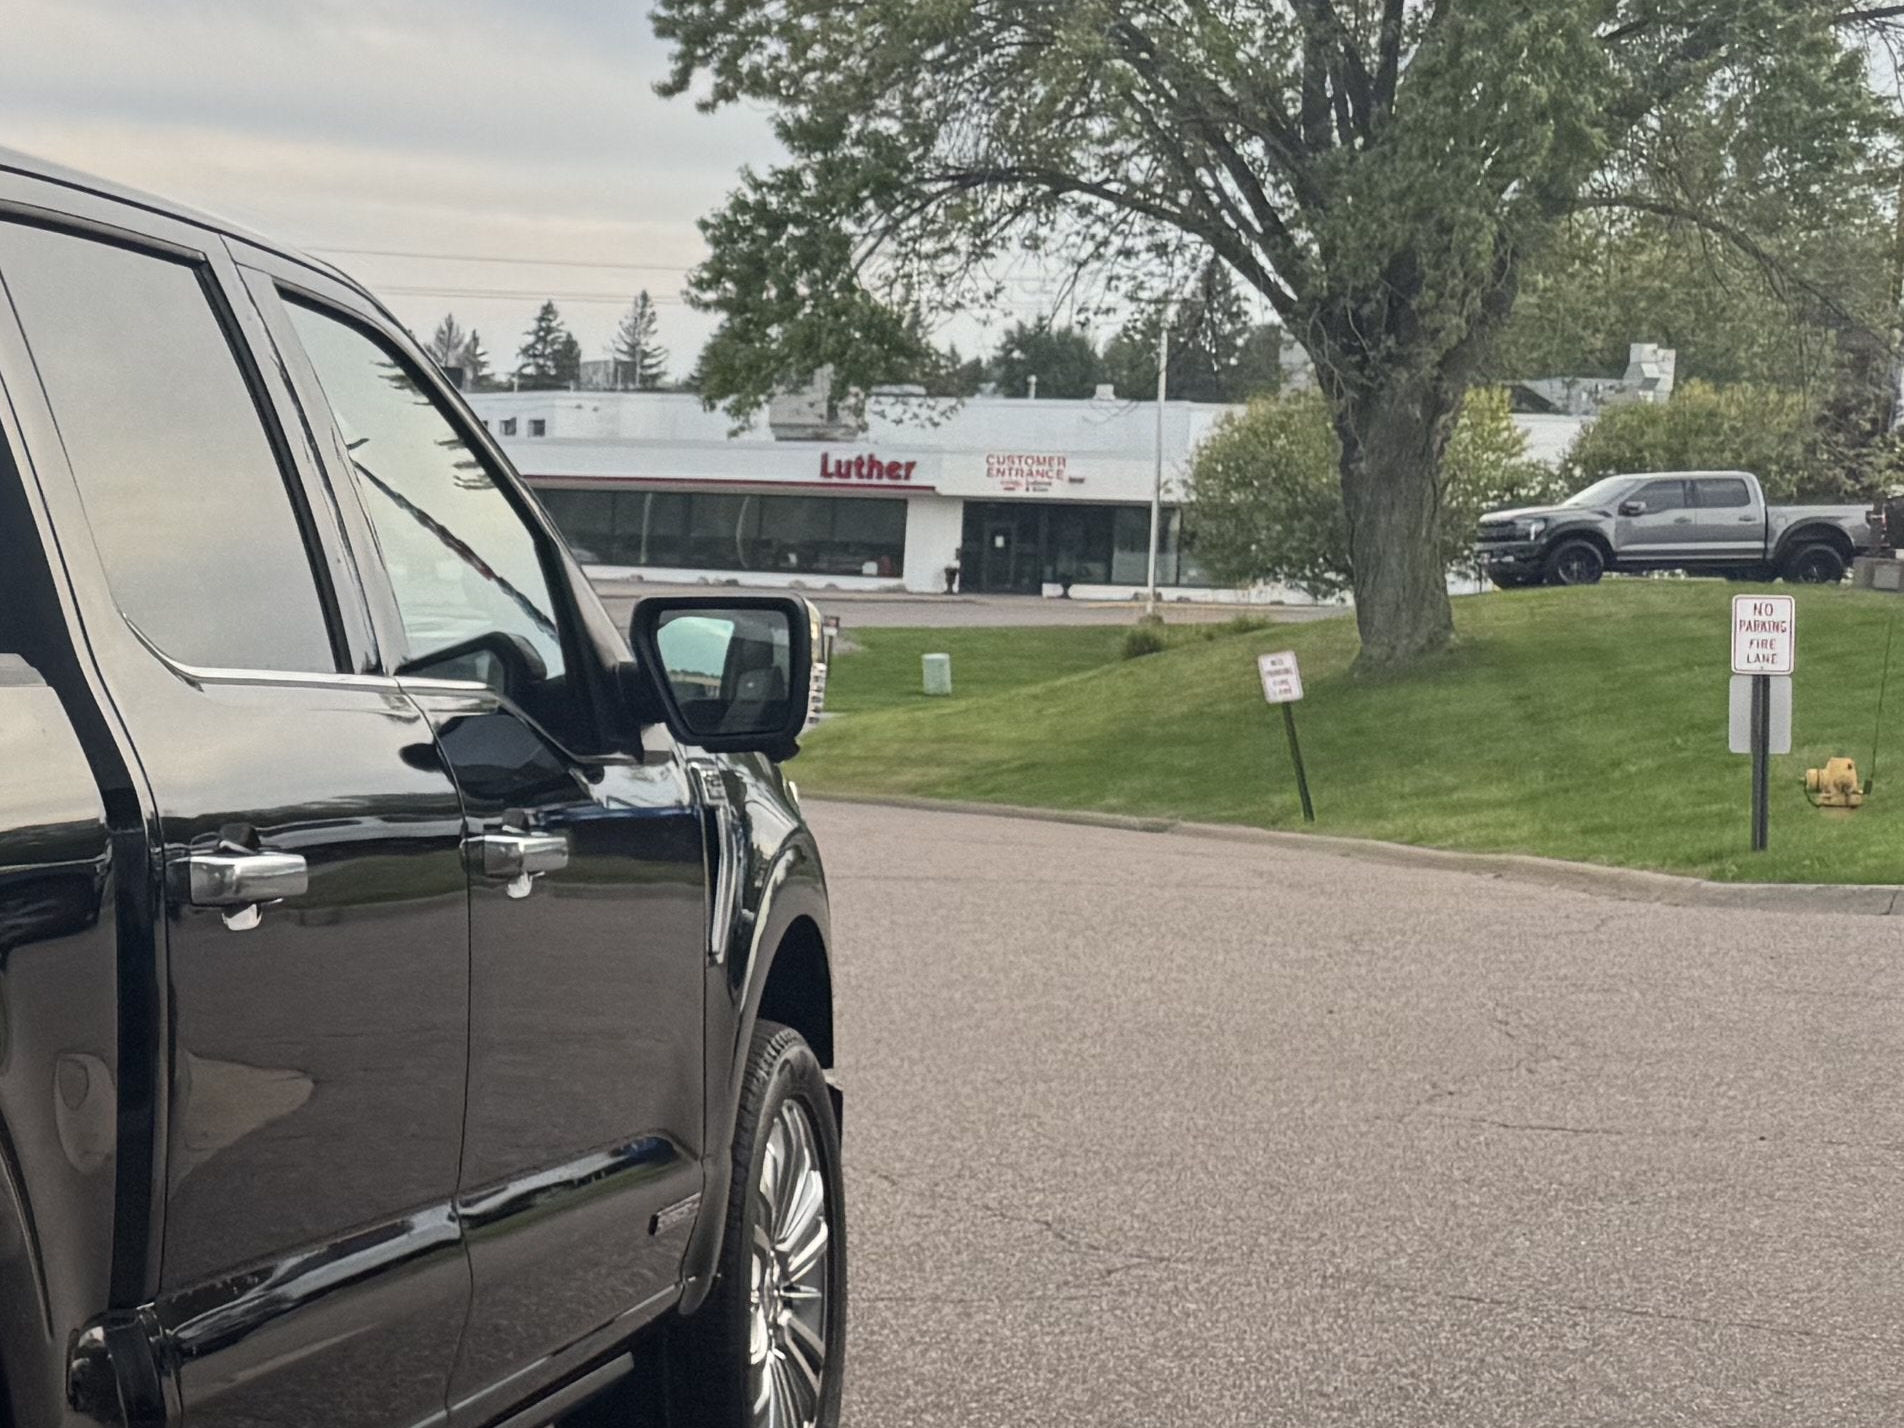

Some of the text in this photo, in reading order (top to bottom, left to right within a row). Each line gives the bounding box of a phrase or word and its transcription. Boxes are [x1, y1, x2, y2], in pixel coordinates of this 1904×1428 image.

[819, 451, 917, 481] Luther
[985, 453, 1067, 468] CUSTOMER
[985, 467, 1065, 481] ENTRANCE
[1753, 602, 1773, 616] NO
[1739, 619, 1787, 633] PARKING
[1749, 638, 1776, 649] FIRE
[1746, 653, 1777, 664] LANE
